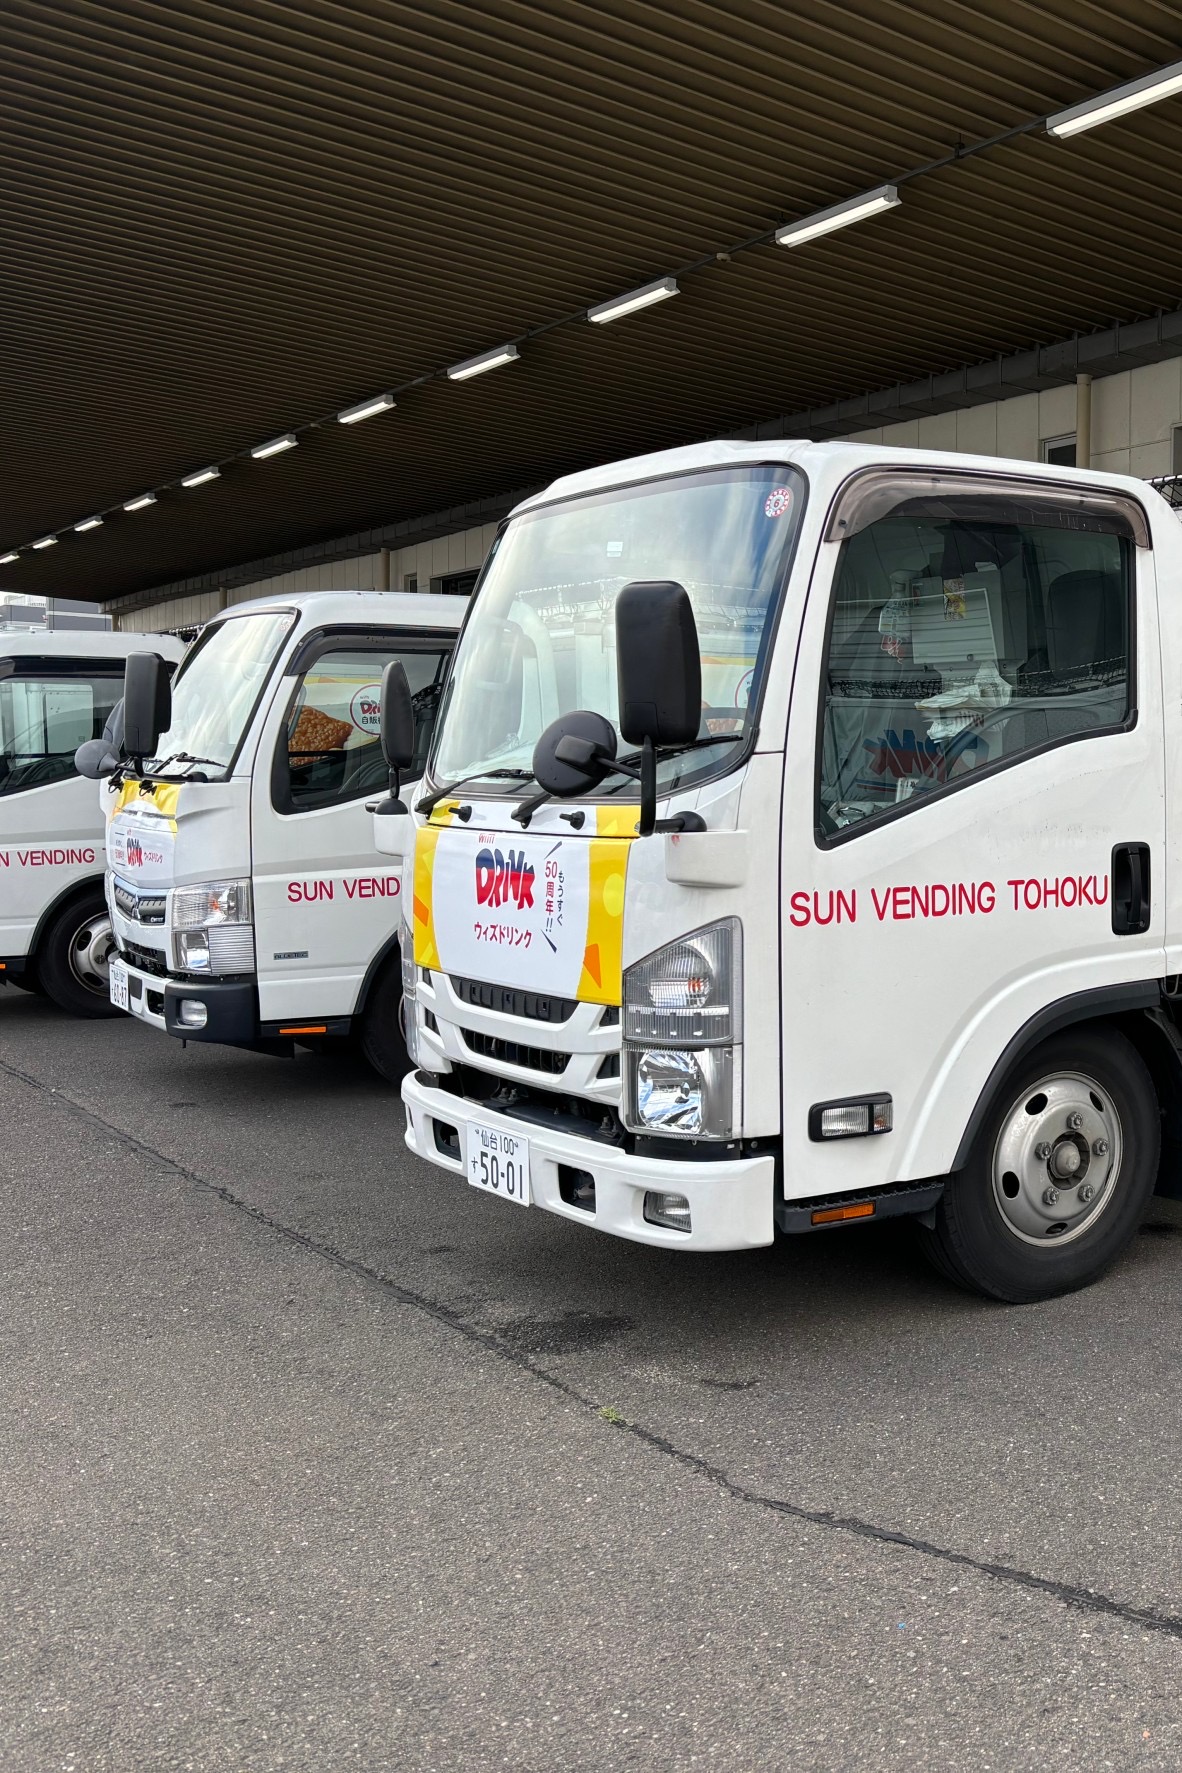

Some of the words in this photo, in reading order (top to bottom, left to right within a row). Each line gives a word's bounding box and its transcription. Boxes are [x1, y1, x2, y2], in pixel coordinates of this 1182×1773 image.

[17, 848, 95, 867] VENDING
[475, 848, 535, 911] DRINK
[287, 881, 334, 903] SUN
[556, 869, 565, 926] もうすぐ
[789, 888, 857, 928] SUN
[870, 880, 996, 922] VENDING
[1007, 874, 1109, 912] TOHOKU
[474, 921, 533, 949] ウィズドリンク
[480, 1150, 523, 1200] 50-01
